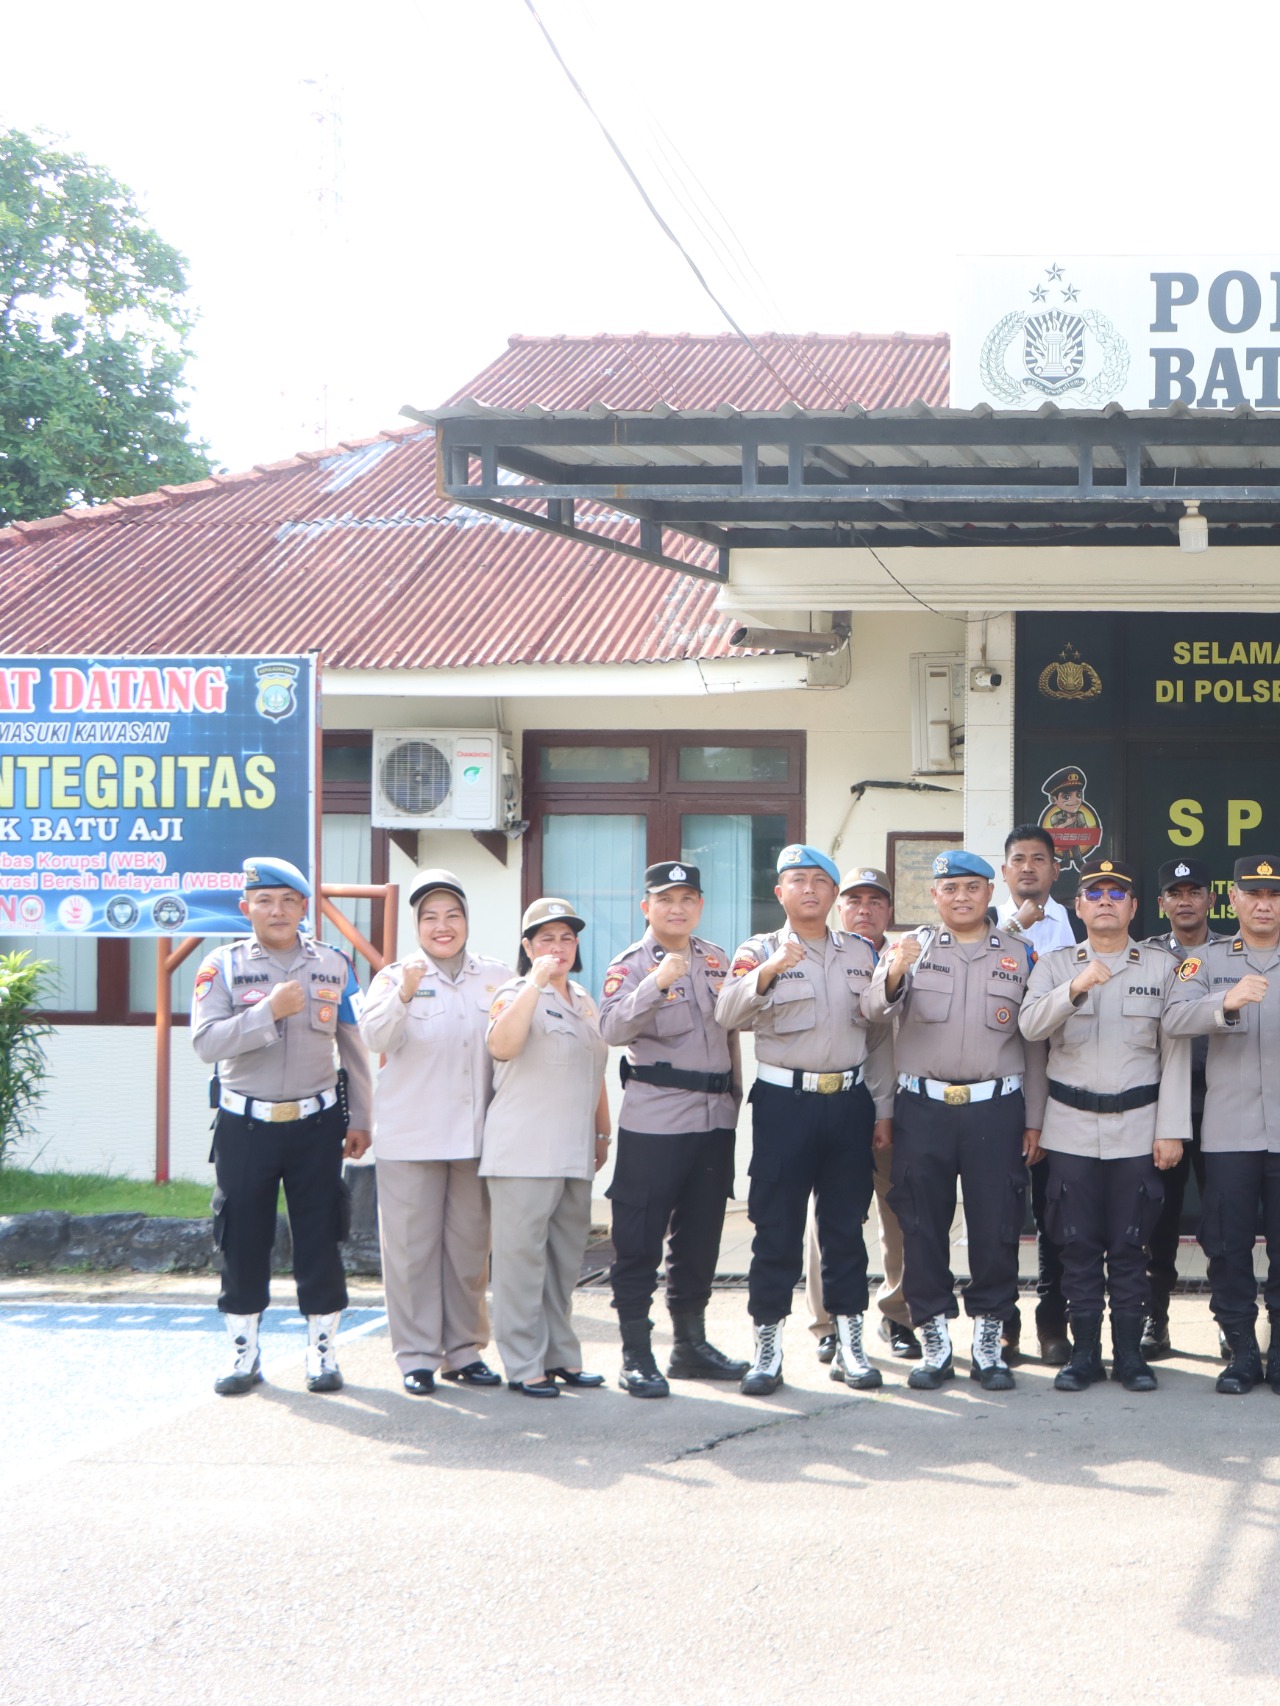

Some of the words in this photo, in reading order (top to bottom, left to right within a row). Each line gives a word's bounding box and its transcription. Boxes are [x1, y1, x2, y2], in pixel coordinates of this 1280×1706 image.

[51, 669, 226, 711] DATANG
[1155, 680, 1184, 703] DI
[73, 722, 168, 742] KAWASAN
[30, 817, 119, 842] BATU
[128, 817, 184, 842] AJI
[38, 853, 106, 872] Korupsi
[109, 853, 166, 872] (WBK)
[42, 873, 98, 889] Bersih
[103, 873, 179, 891] Melayani
[311, 973, 341, 985] POLRI
[991, 970, 1022, 984] POLRI
[1128, 986, 1161, 997] POLRI
